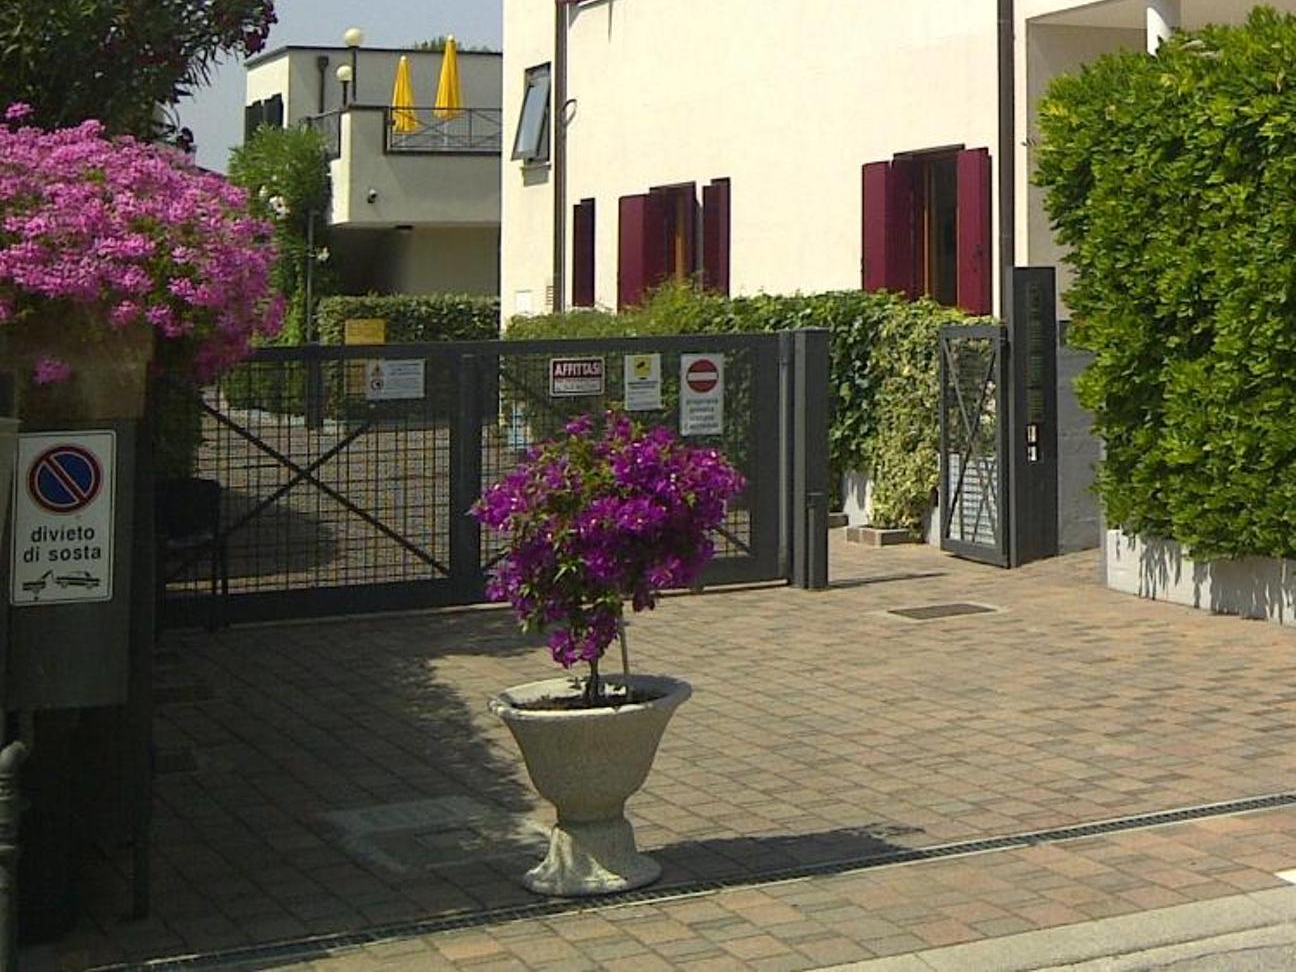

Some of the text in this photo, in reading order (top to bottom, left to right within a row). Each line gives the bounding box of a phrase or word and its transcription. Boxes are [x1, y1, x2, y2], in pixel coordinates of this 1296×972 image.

[554, 362, 600, 376] AFFITTASI
[31, 526, 95, 543] divieto
[23, 546, 102, 562] di sosta
